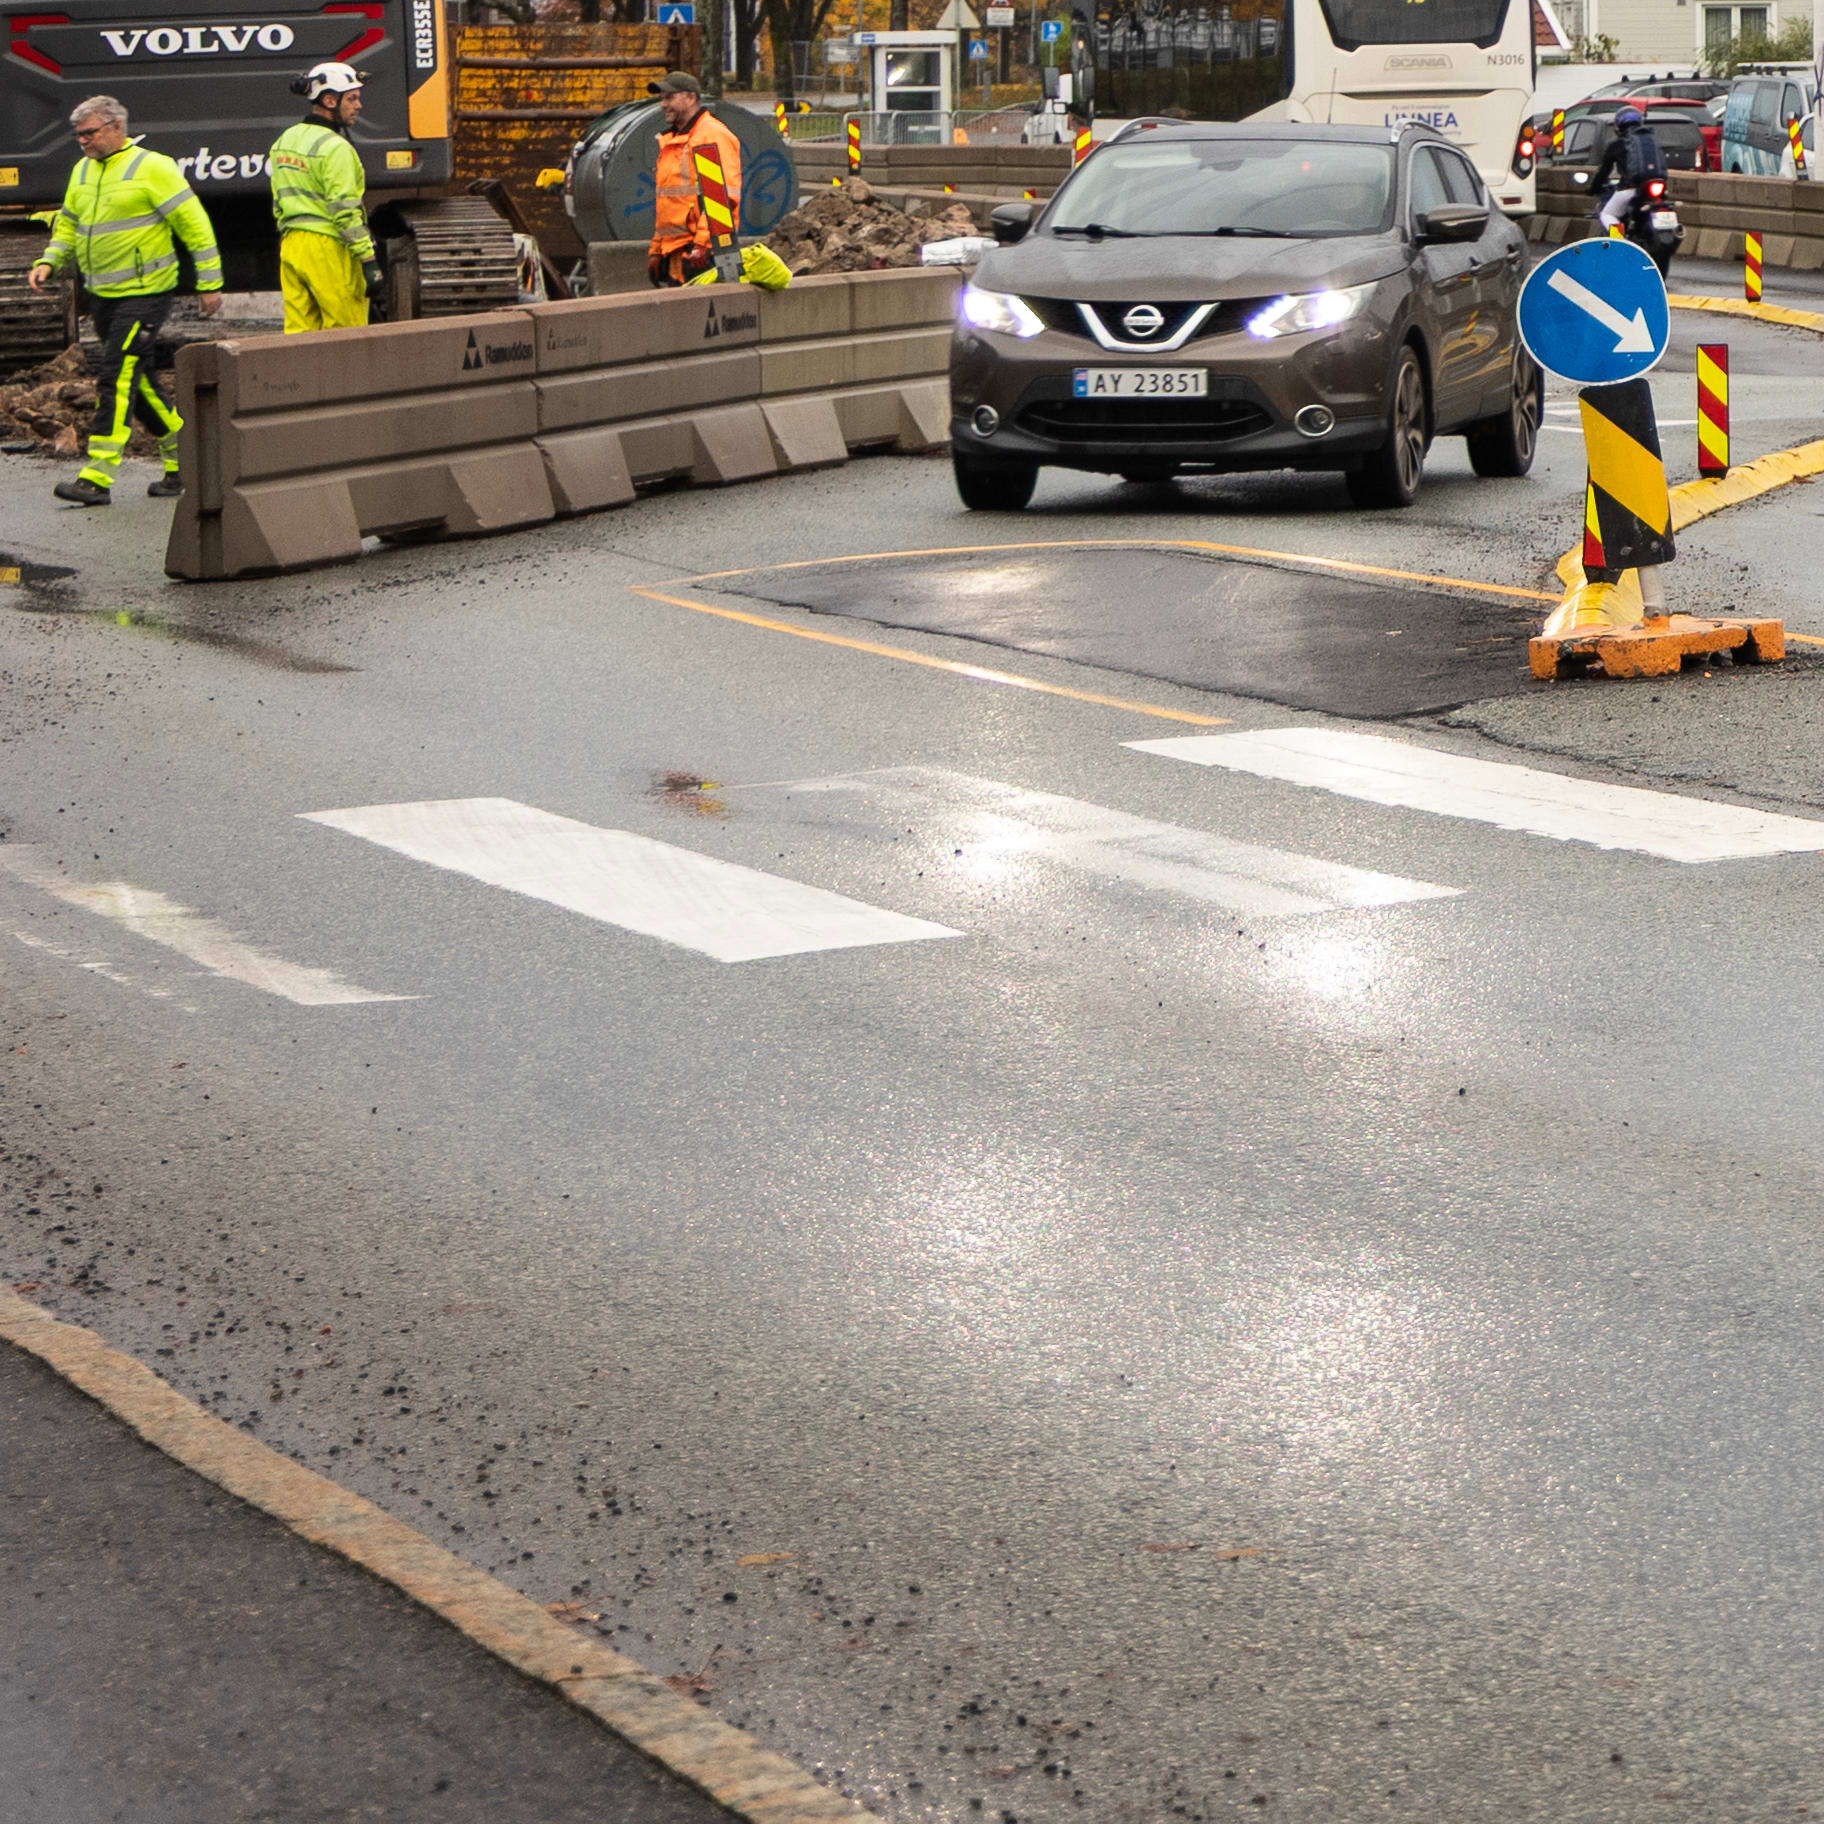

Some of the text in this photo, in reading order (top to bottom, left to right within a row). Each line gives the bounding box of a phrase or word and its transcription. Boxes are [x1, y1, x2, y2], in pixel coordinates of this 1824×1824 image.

[101, 23, 295, 57] VOLVO
[1389, 58, 1447, 68] SCANIA
[1487, 55, 1525, 66] N3016
[485, 341, 533, 365] Ramudden
[1094, 373, 1199, 392] AY 23851
